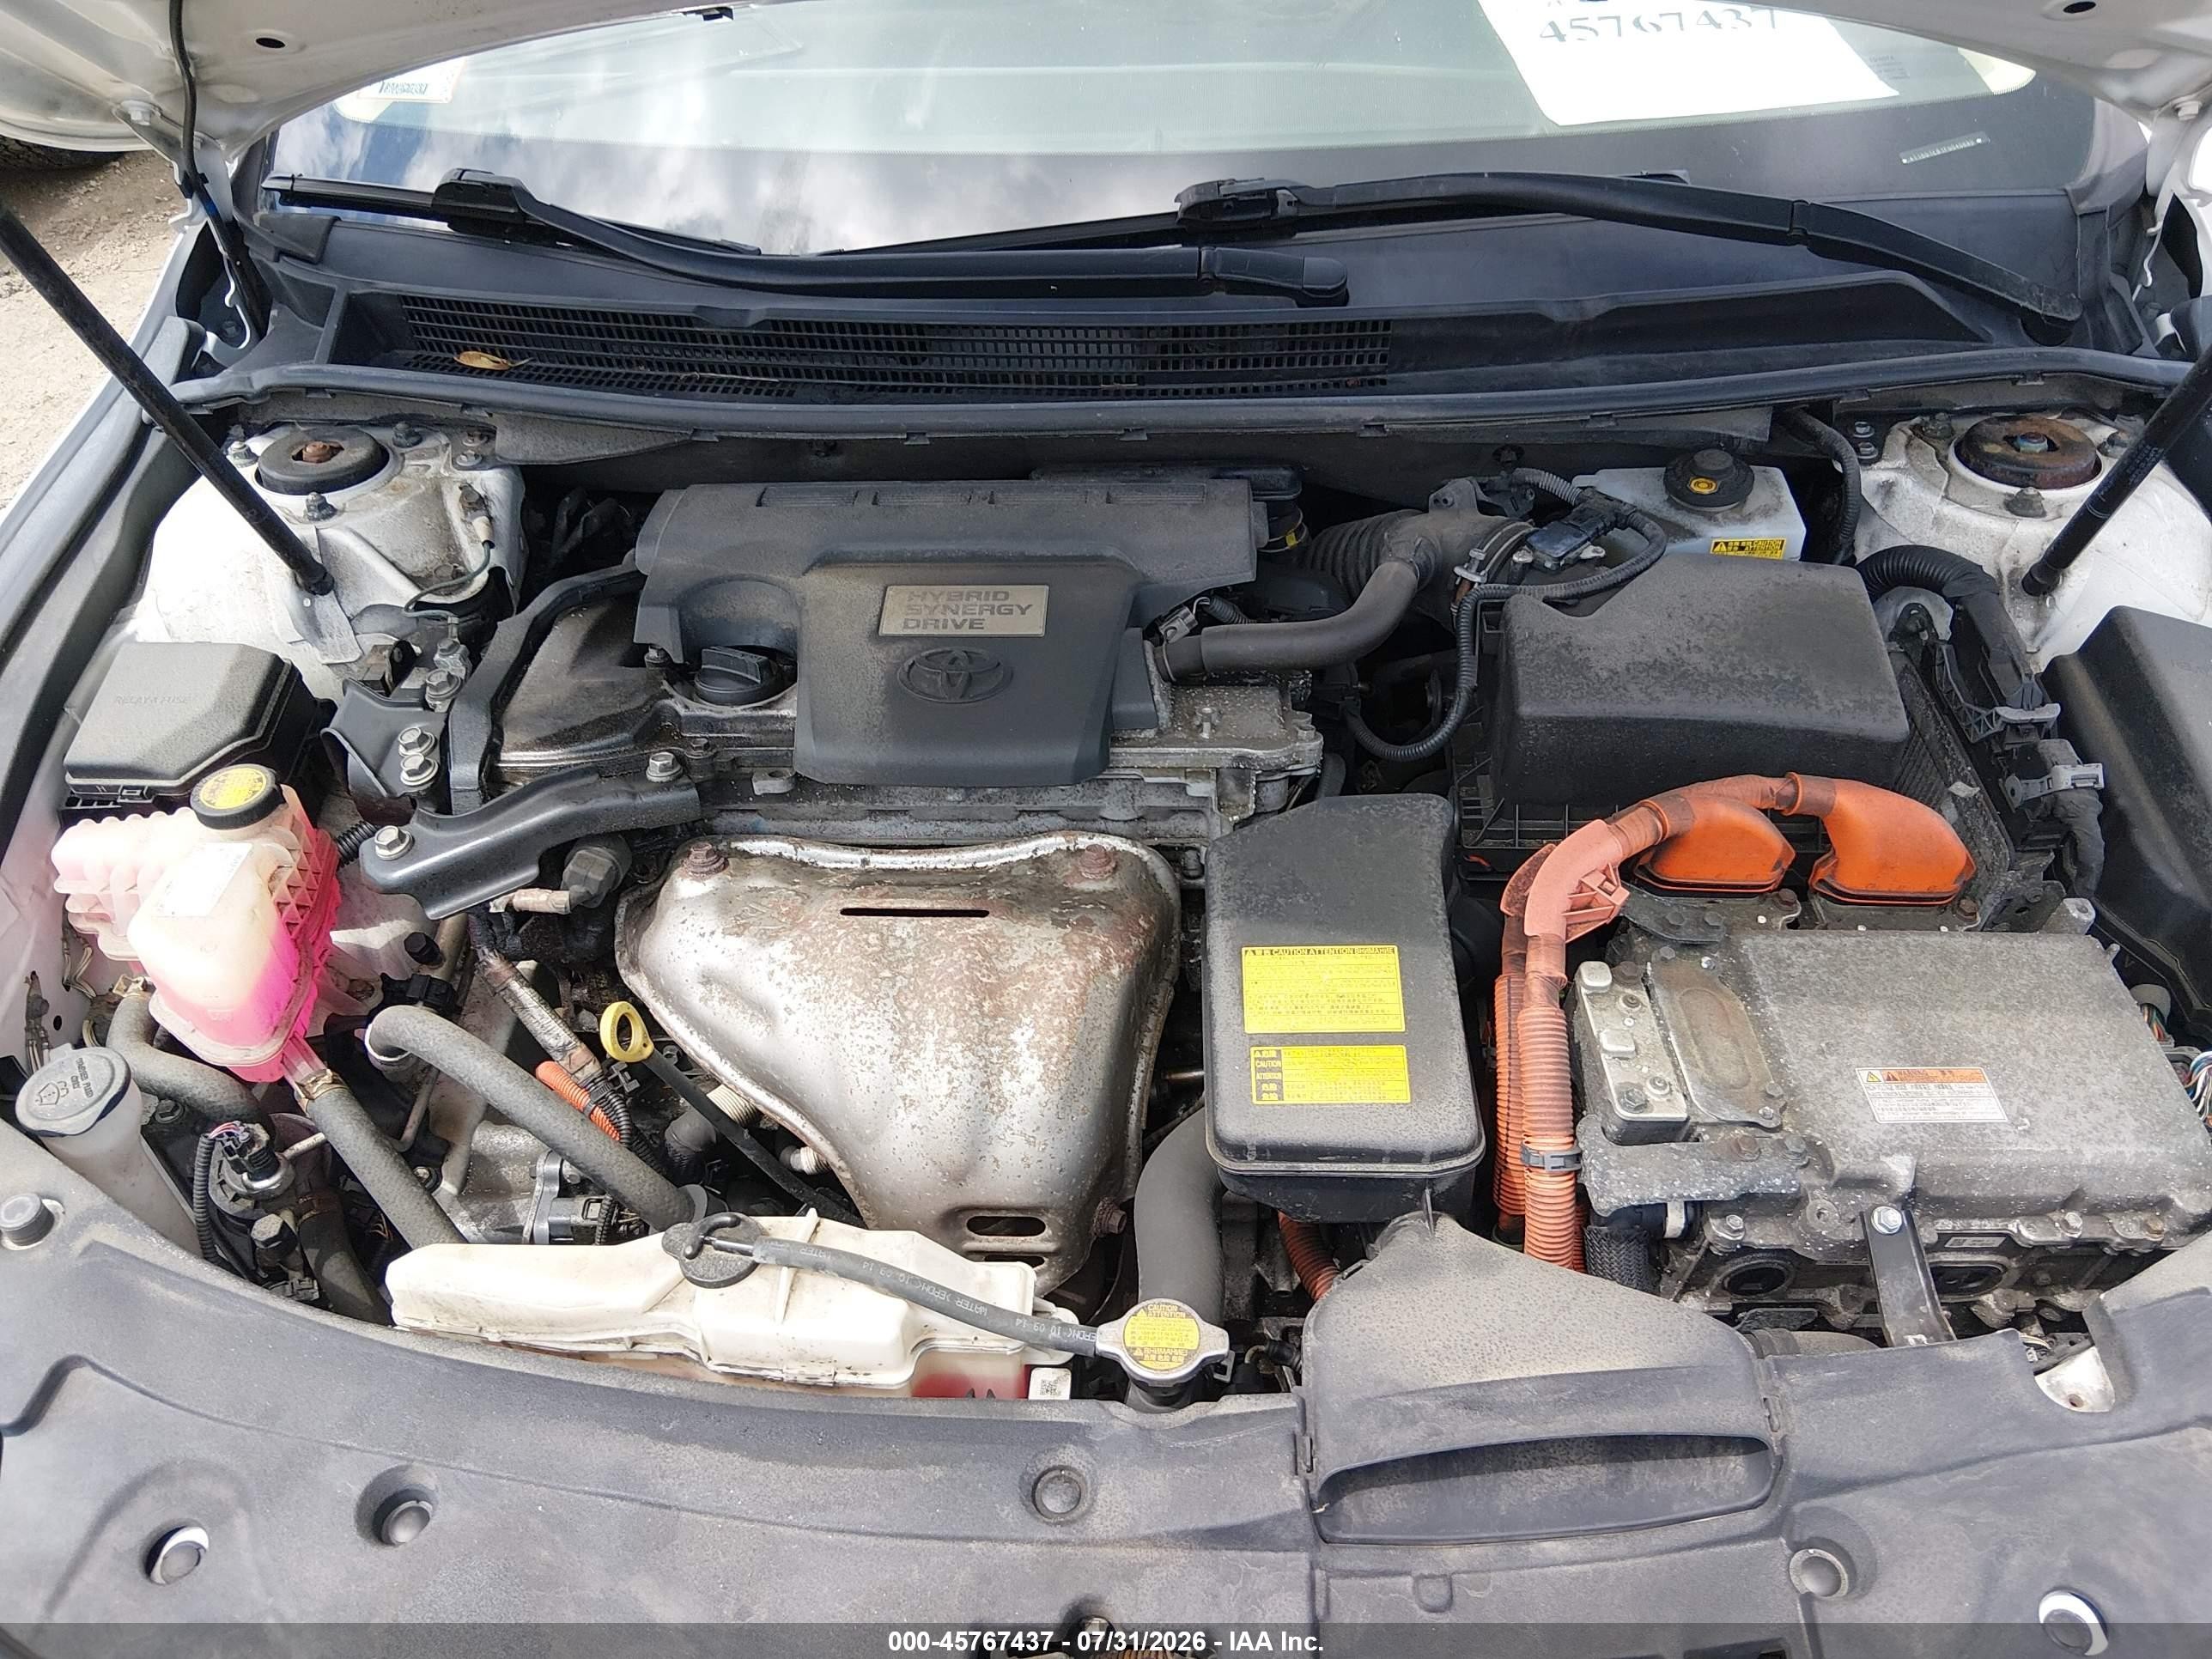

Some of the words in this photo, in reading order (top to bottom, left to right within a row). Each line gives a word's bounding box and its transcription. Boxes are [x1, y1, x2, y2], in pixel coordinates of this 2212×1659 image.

[1540, 8, 1777, 42] 45767437
[907, 590, 1010, 602] HYBRID
[905, 604, 1034, 616] SYNERGY
[902, 617, 985, 630] DRIVE
[1310, 947, 1354, 956] ATTENTION
[1255, 1060, 1282, 1068] CAUTION
[955, 1298, 988, 1316] WATER
[1016, 1318, 1027, 1328] 14
[1033, 1323, 1045, 1332] 09
